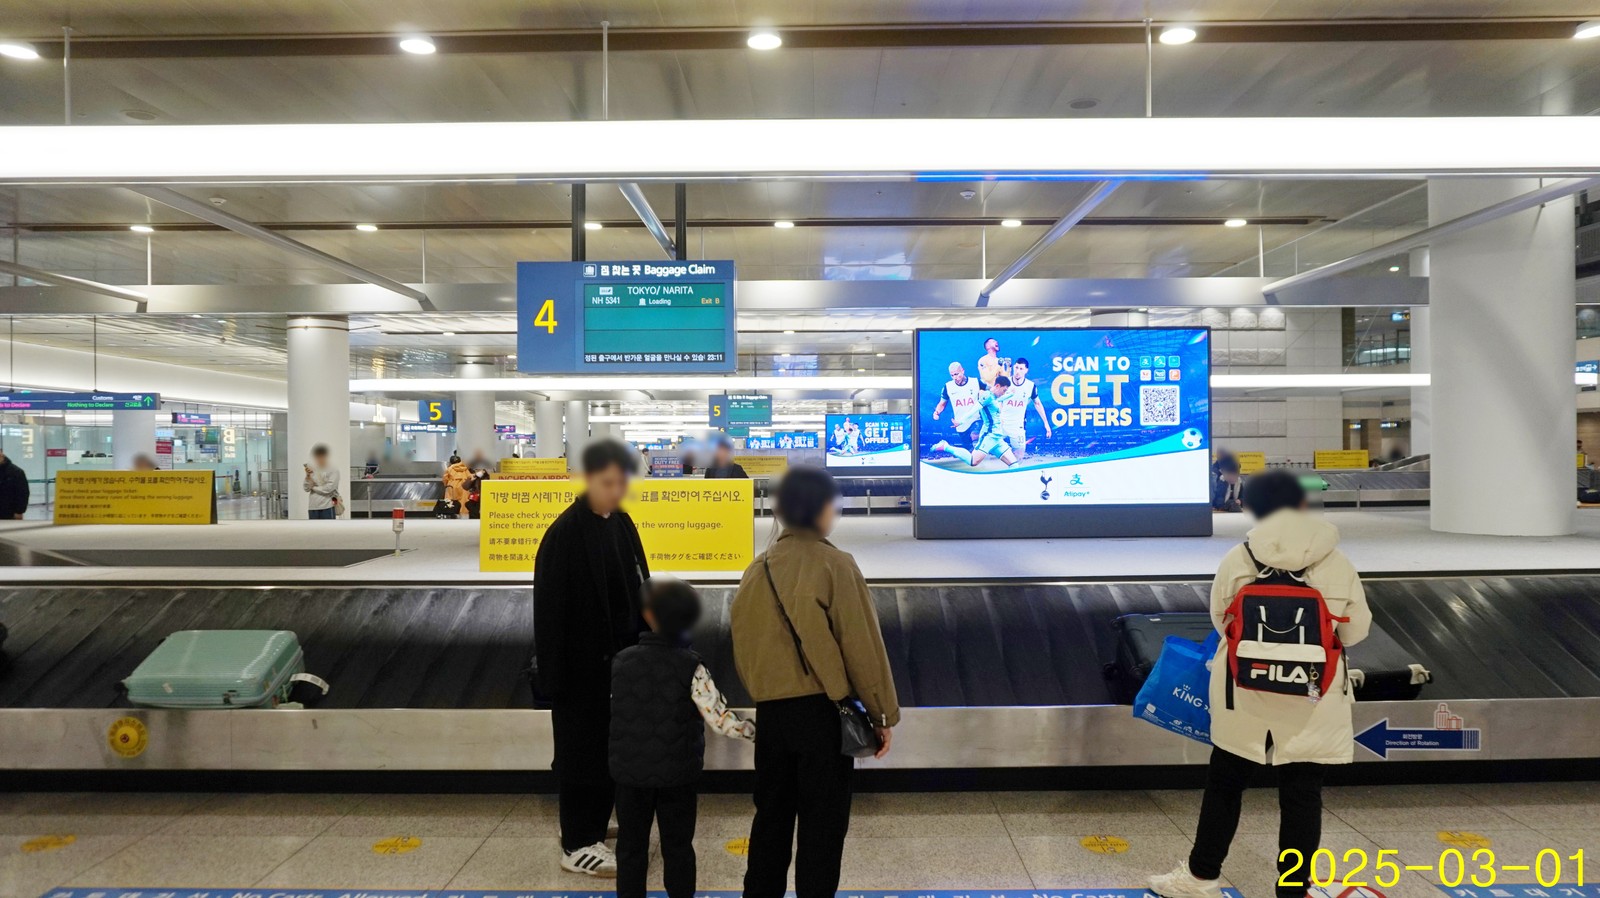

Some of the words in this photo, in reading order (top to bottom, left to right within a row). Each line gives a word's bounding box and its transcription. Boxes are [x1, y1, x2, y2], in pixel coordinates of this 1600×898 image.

[600, 265, 610, 276] 짐
[612, 265, 630, 276] 찾는
[644, 265, 687, 277] Baggage
[688, 264, 716, 275] Claim
[627, 286, 661, 296] TOKYO/
[663, 286, 694, 295] NARITA
[648, 298, 672, 306] Loading
[533, 299, 558, 334] 4
[1052, 356, 1100, 371] SCAN
[1108, 356, 1130, 371] TO
[1050, 374, 1130, 407] GET
[955, 397, 975, 407] AIA
[1007, 399, 1024, 407] AIA
[429, 402, 442, 421] 5
[713, 405, 721, 417] 5
[1051, 407, 1133, 427] OFFERS
[864, 427, 889, 438] GET
[490, 492, 509, 503] 가방
[511, 492, 530, 503] 바뀜
[532, 491, 562, 503] 사례가
[640, 491, 659, 502] 표를
[661, 490, 701, 502] 확인하여
[489, 511, 515, 519] Please
[517, 511, 540, 519] check
[512, 521, 534, 529] there
[642, 521, 656, 529] the
[658, 522, 685, 530] wrong
[687, 521, 724, 530] luggage.
[1250, 662, 1309, 684] FILA
[1172, 686, 1204, 708] KING
